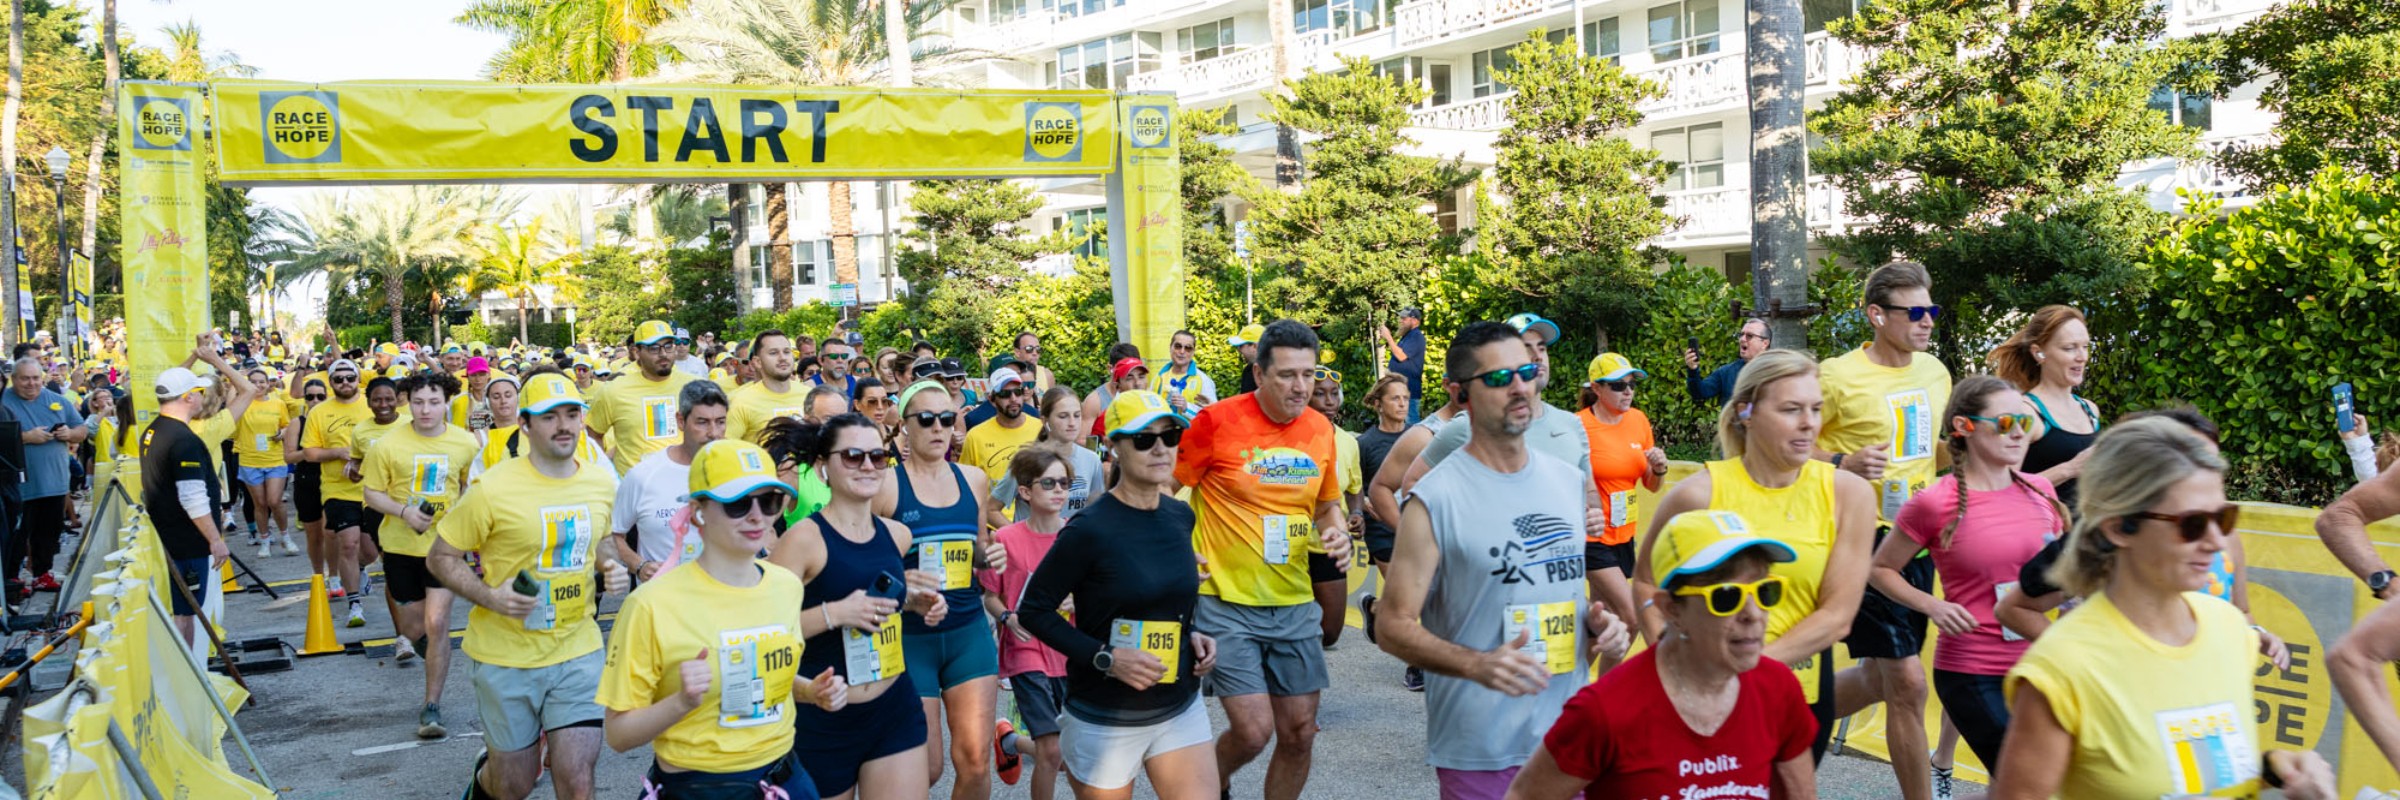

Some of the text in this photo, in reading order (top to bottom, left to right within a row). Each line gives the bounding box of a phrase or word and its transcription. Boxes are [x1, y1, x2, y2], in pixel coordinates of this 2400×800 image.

[143, 112, 181, 122] RACE
[274, 112, 327, 124] RACE
[1136, 117, 1164, 126] RACE
[143, 125, 182, 136] HOPE
[569, 94, 840, 163] START
[1034, 119, 1074, 130] RACE
[275, 130, 329, 143] HOPE
[1137, 128, 1165, 137] HOPE
[1034, 134, 1074, 145] HOPE
[543, 509, 584, 522] HOPE
[1289, 523, 1308, 537] 1246
[945, 549, 968, 563] 1445
[1547, 545, 1577, 557] TEAM
[572, 557, 583, 567] 5K
[554, 584, 581, 601] 1266
[1147, 632, 1174, 650] 1315
[764, 646, 793, 672] 1176
[1679, 754, 1738, 777] Publix
